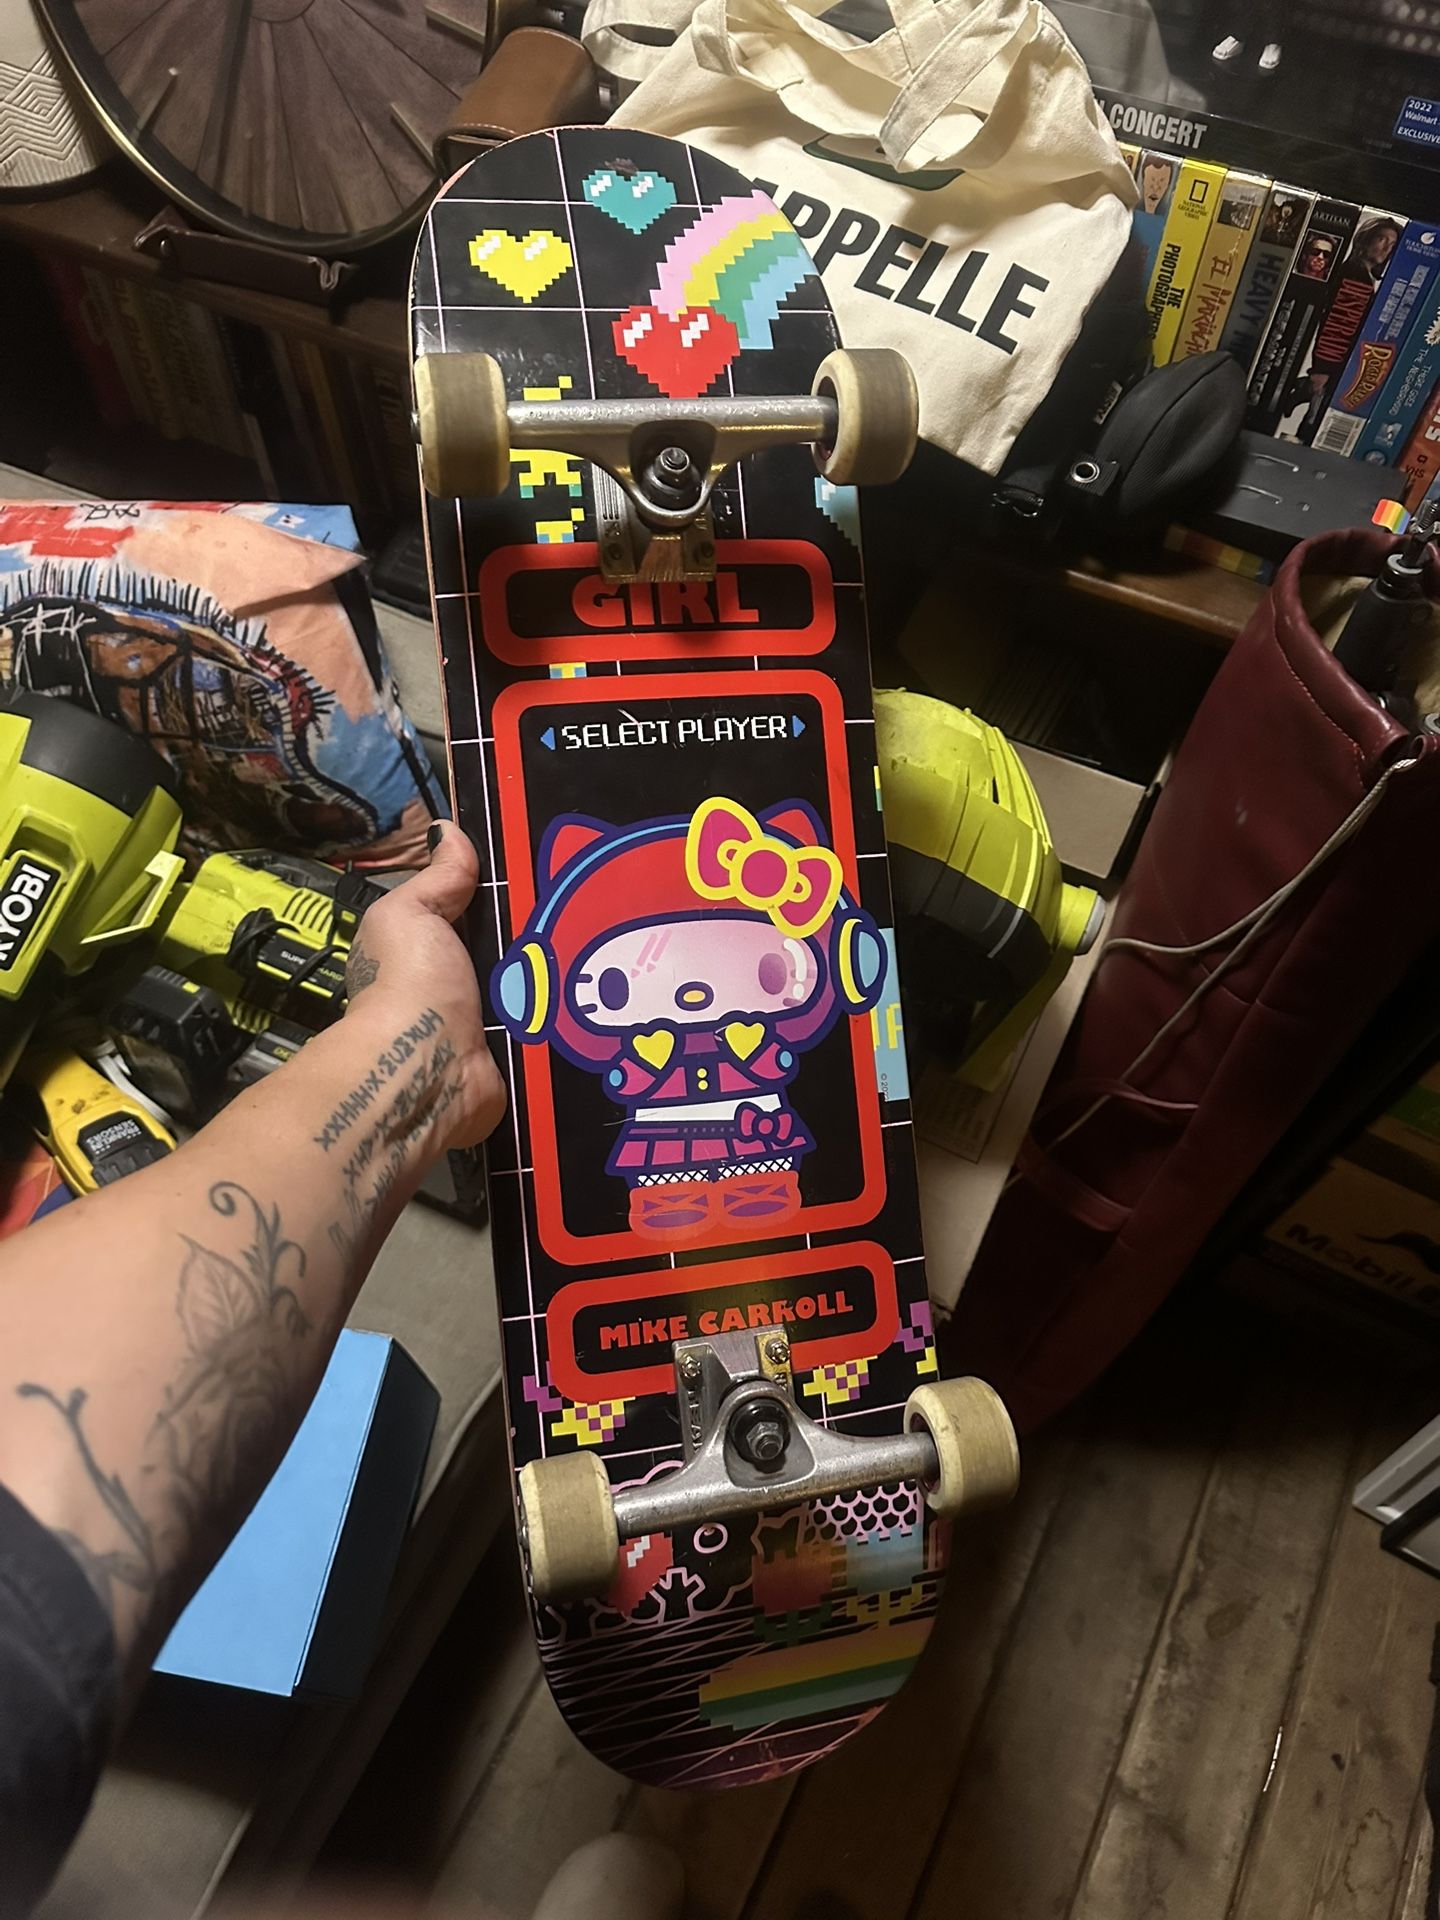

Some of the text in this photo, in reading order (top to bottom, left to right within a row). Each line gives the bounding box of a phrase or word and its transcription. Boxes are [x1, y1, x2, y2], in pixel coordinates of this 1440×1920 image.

[1405, 110, 1438, 125] Walmart
[1408, 99, 1432, 112] 2022
[1109, 103, 1208, 149] CONCERT
[1397, 126, 1440, 144] EXCLUSIVE
[1314, 210, 1350, 226] ARTISAN
[751, 177, 1050, 355] PPELLE
[1148, 243, 1185, 340] THE PHOTOGRAPHERS
[1240, 253, 1286, 332] HEAVY
[1313, 278, 1374, 364] DESPERADO
[1413, 348, 1429, 363] THE
[1405, 464, 1426, 479] VHS
[572, 572, 759, 628] GIRL
[561, 715, 788, 750] SELECT PLAYER
[86, 1119, 136, 1143] SENSORS
[600, 1290, 854, 1350] MIKE CARROLL
